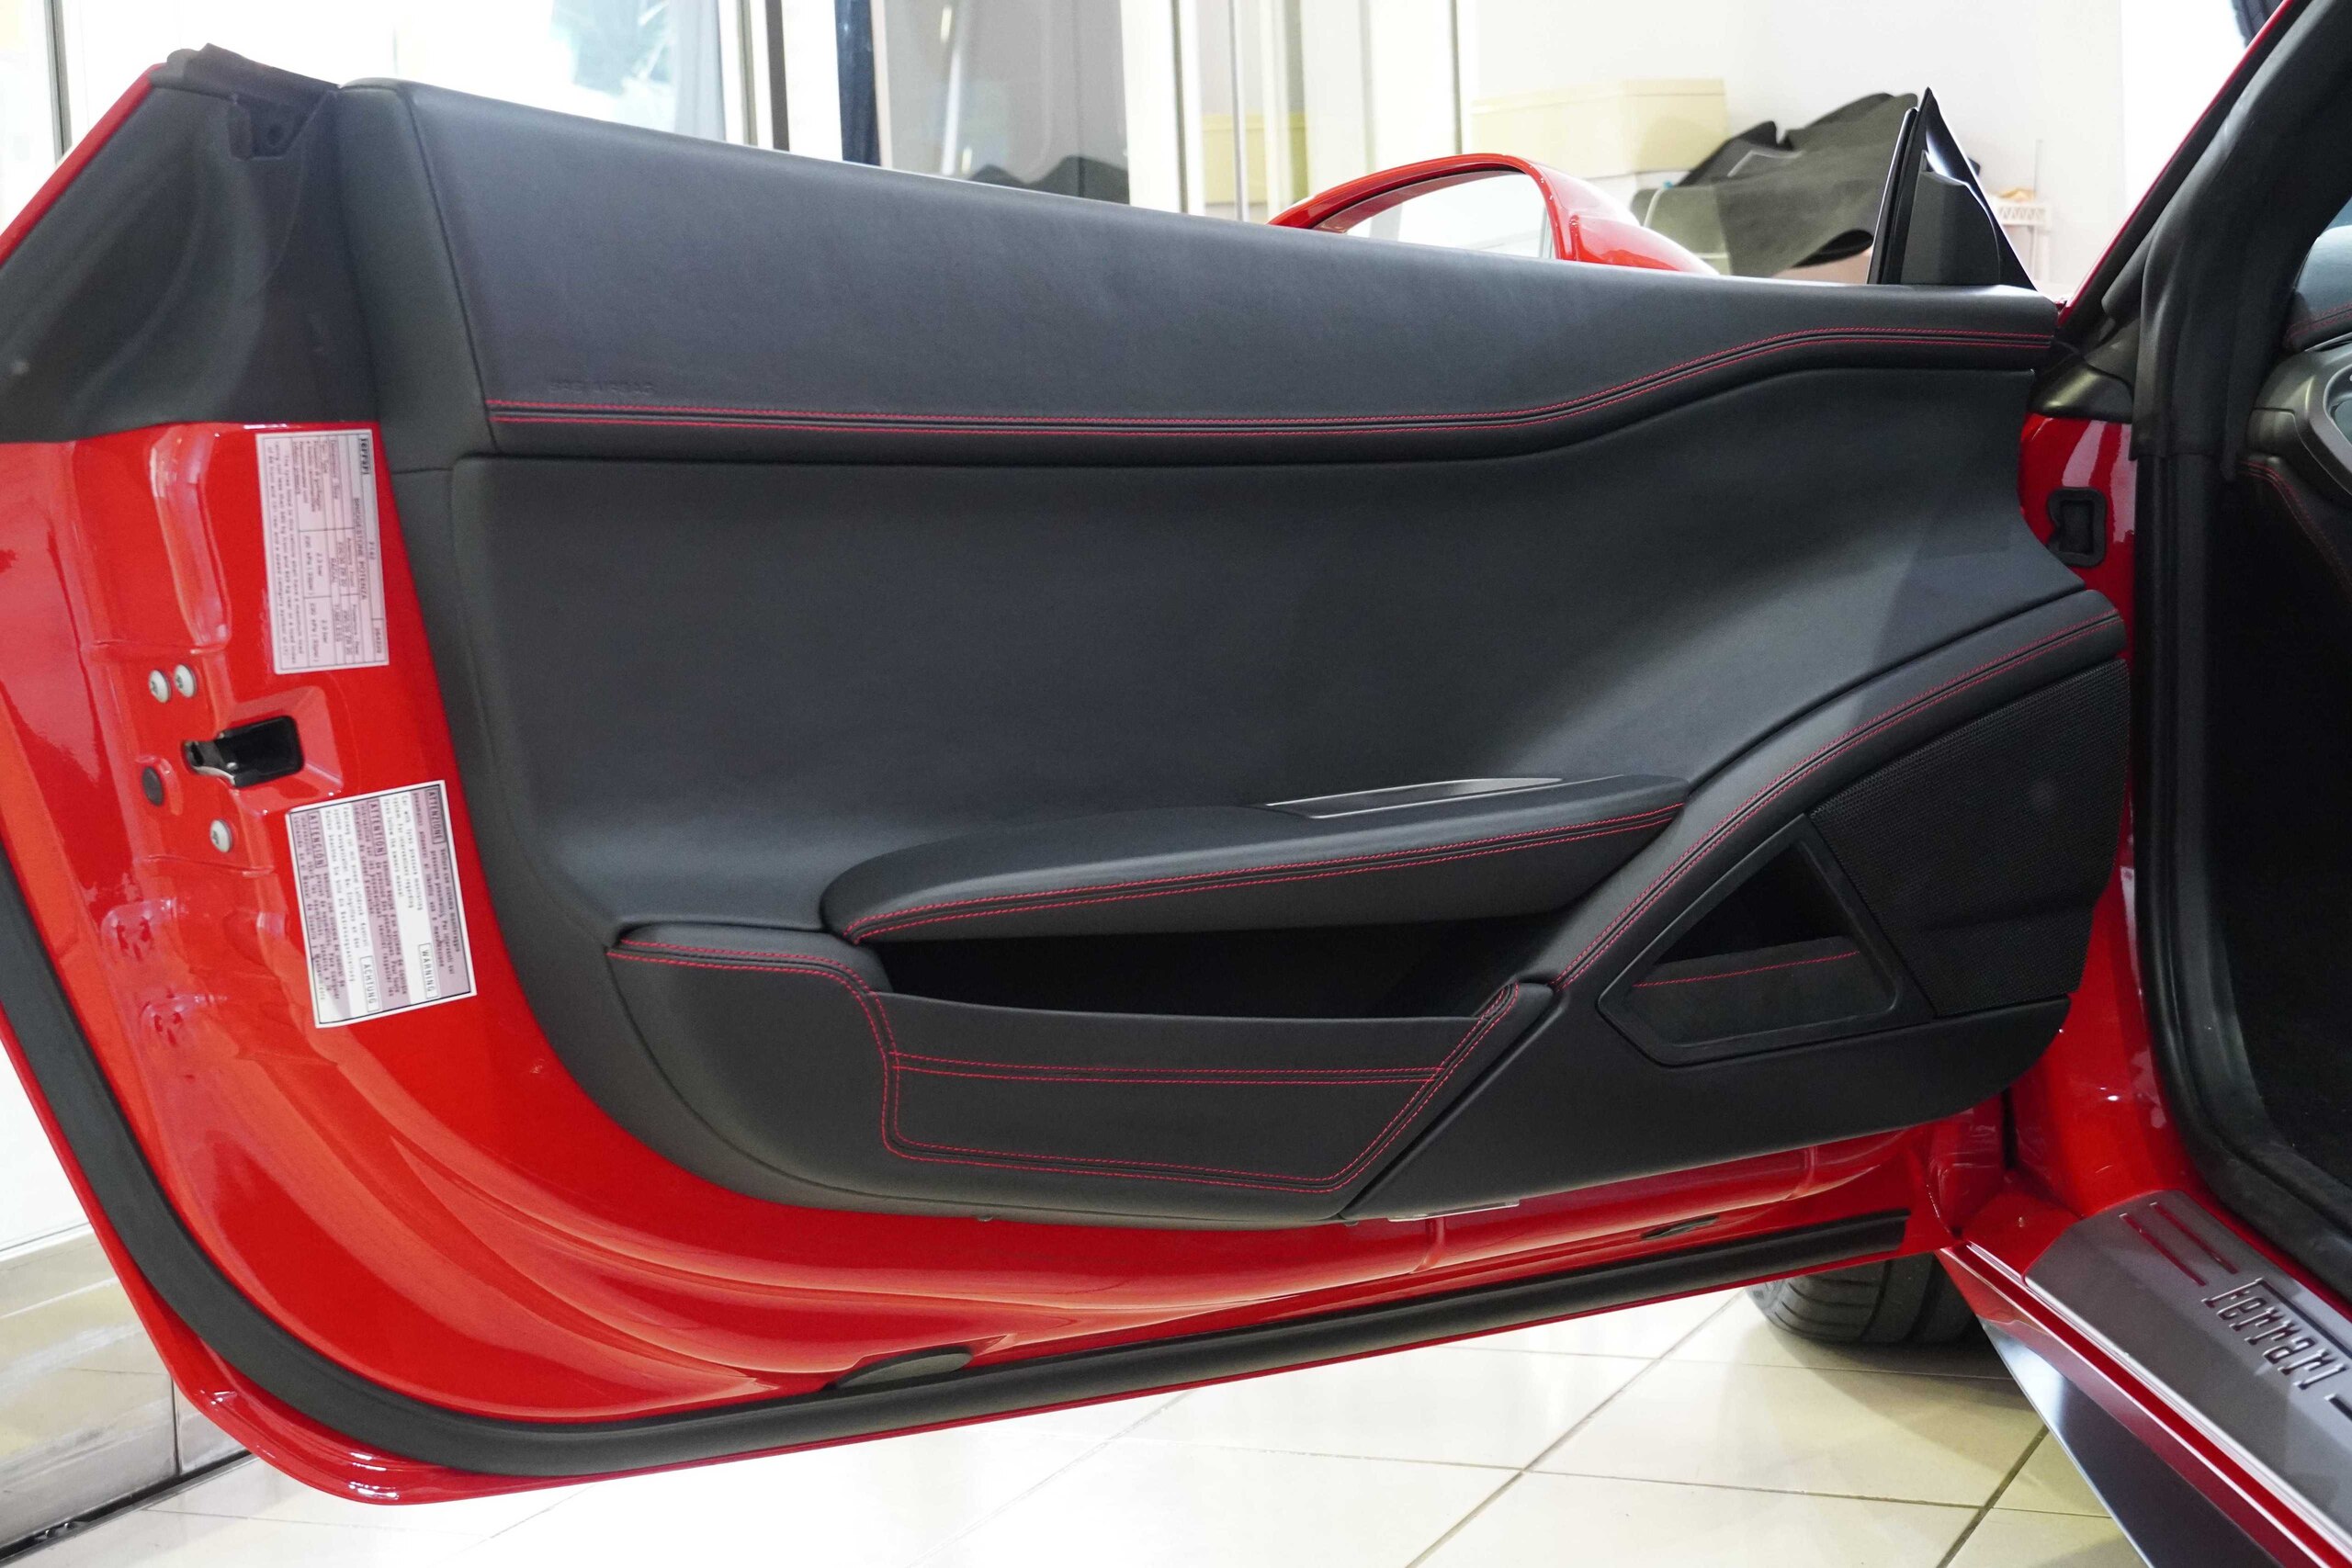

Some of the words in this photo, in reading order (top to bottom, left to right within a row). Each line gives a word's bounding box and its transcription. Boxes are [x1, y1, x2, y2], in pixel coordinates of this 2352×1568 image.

[369, 802, 385, 853] ATTENTION
[427, 790, 443, 840] ATTENZIONE
[362, 963, 377, 1004] ACHTUNG
[421, 949, 435, 991] WARNING
[2201, 1278, 2352, 1391] Ferrari
